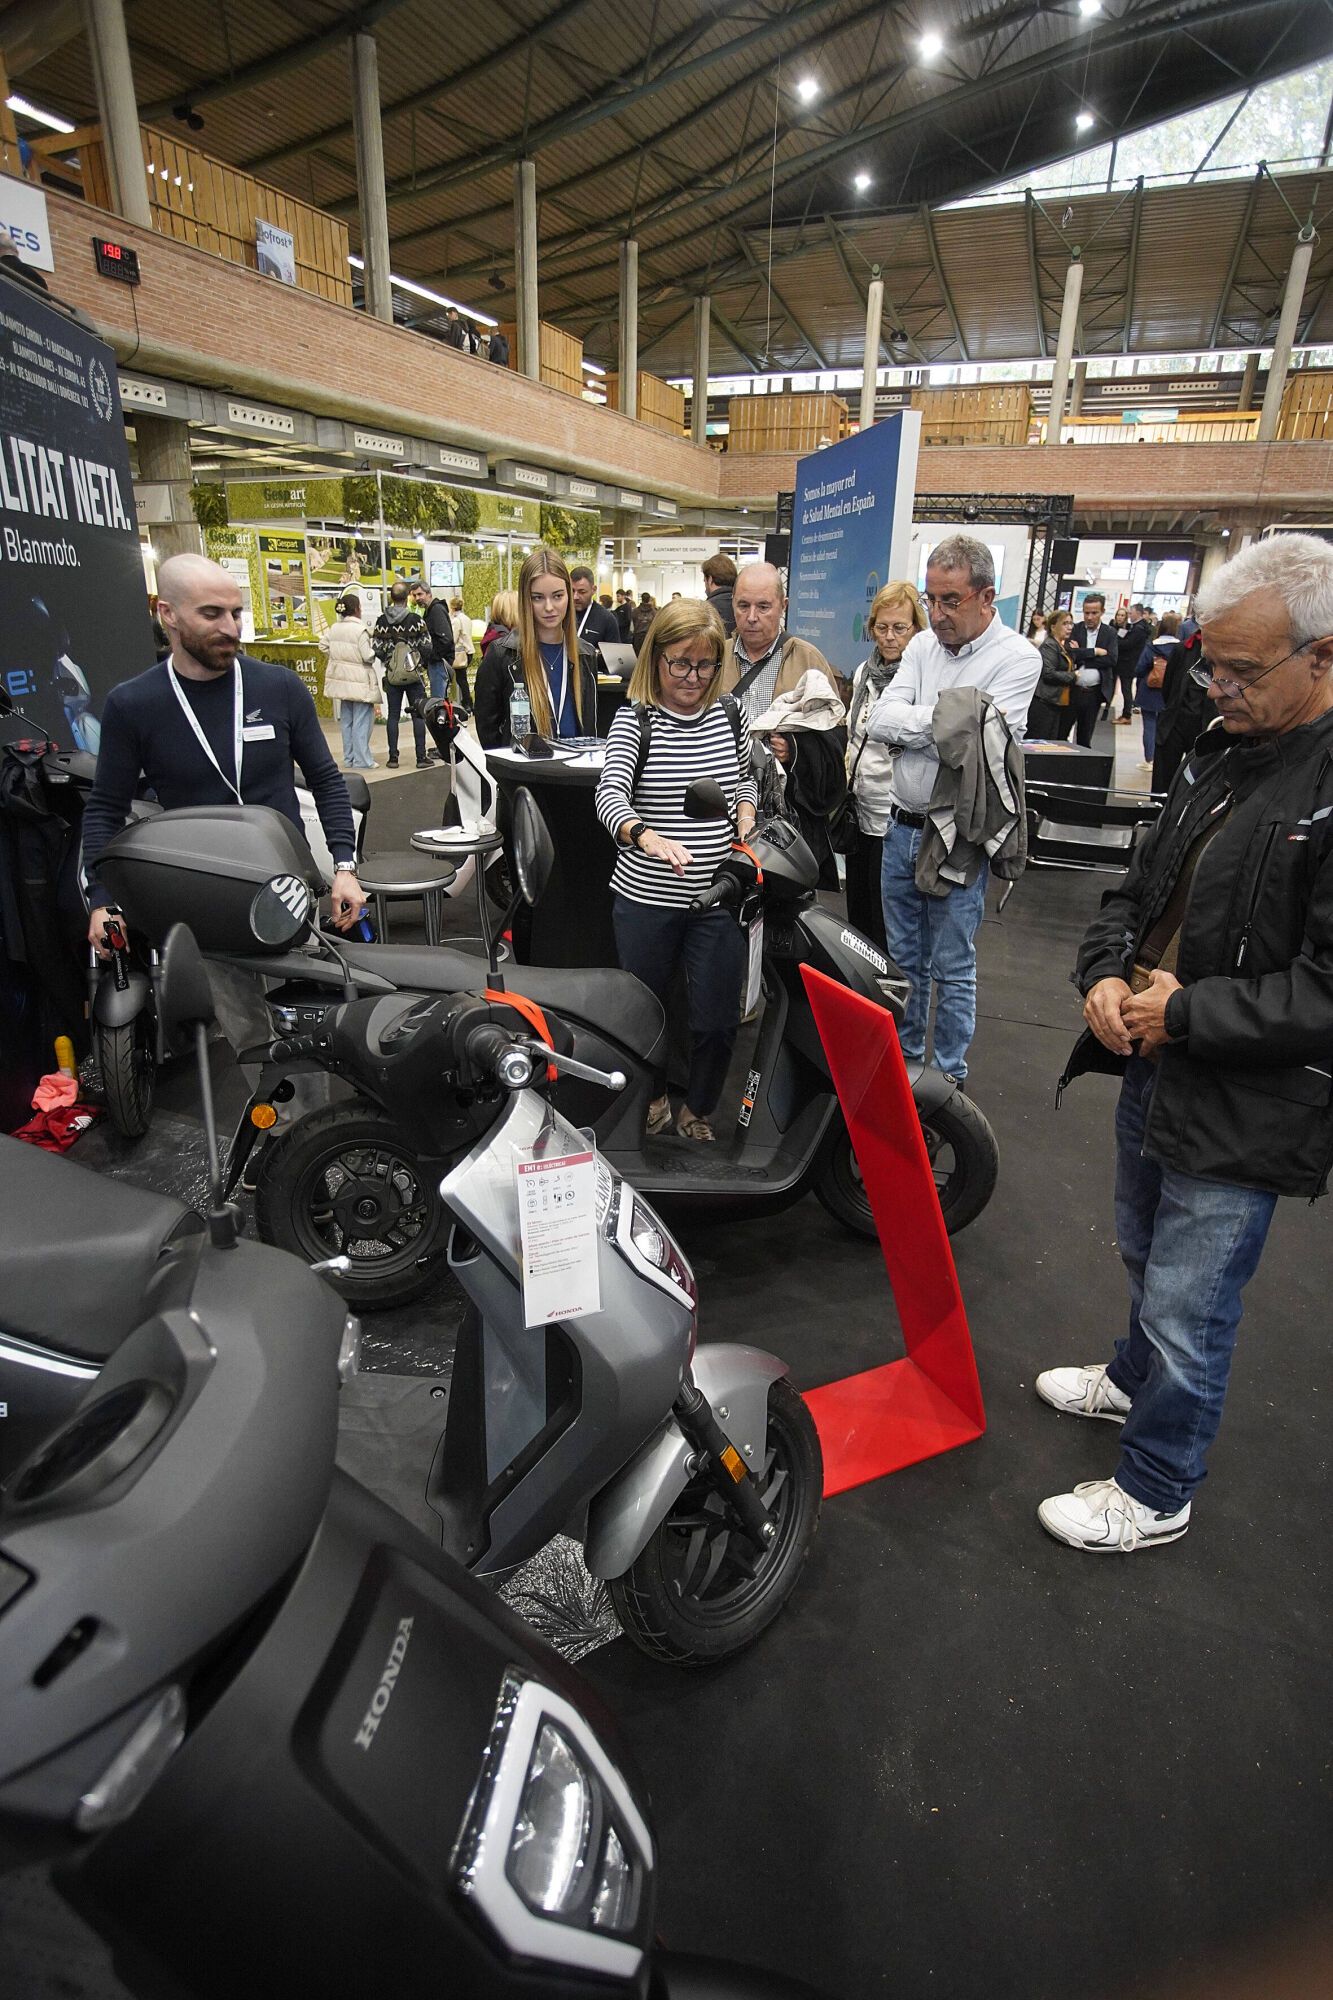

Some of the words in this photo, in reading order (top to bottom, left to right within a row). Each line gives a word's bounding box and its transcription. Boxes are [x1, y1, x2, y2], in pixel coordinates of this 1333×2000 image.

[0, 436, 69, 520] LITAT
[69, 455, 131, 530] NETA.
[844, 469, 856, 489] red
[852, 491, 875, 515] España
[4, 527, 81, 567] Blanmoto.
[555, 1306, 583, 1317] HONDA
[354, 1616, 414, 1750] HONDA
